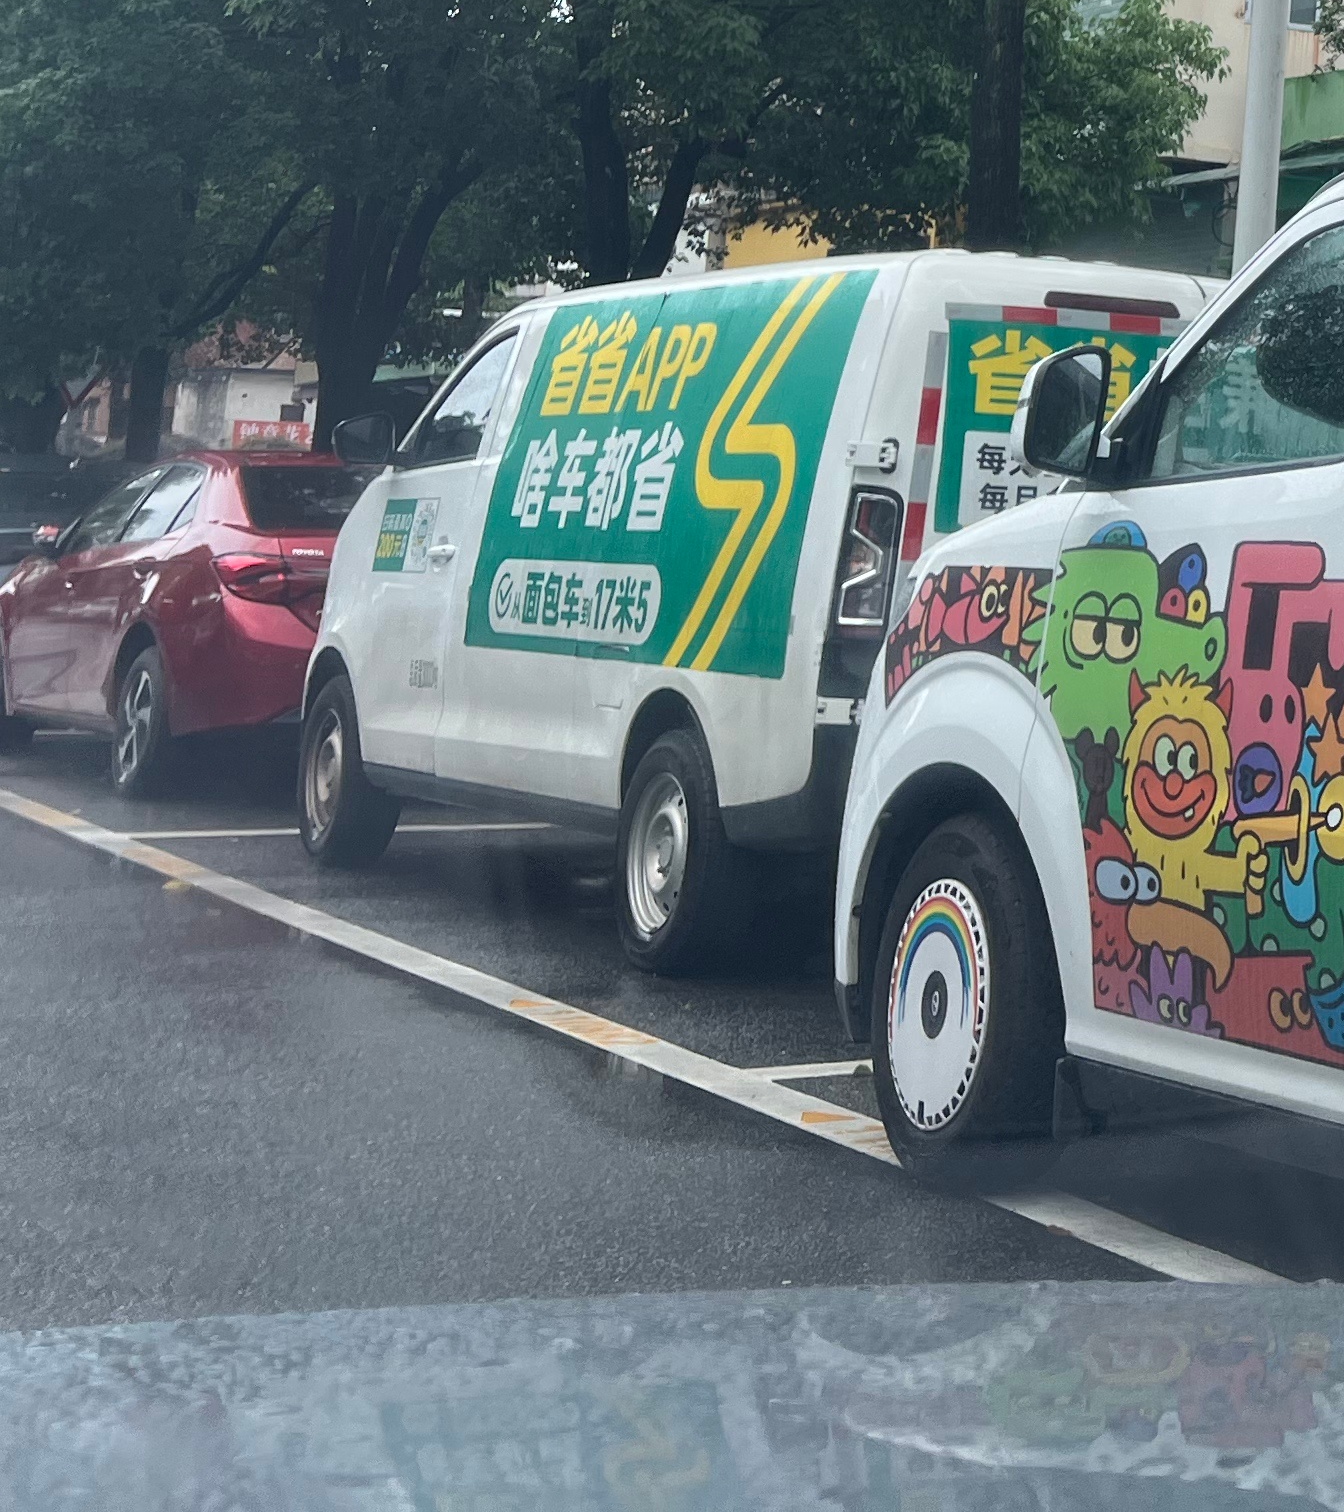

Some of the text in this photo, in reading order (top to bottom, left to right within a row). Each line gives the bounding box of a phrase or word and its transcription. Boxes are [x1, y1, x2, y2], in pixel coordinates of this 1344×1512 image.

[540, 310, 718, 416] 省省APP
[511, 421, 684, 532] 啥车都省
